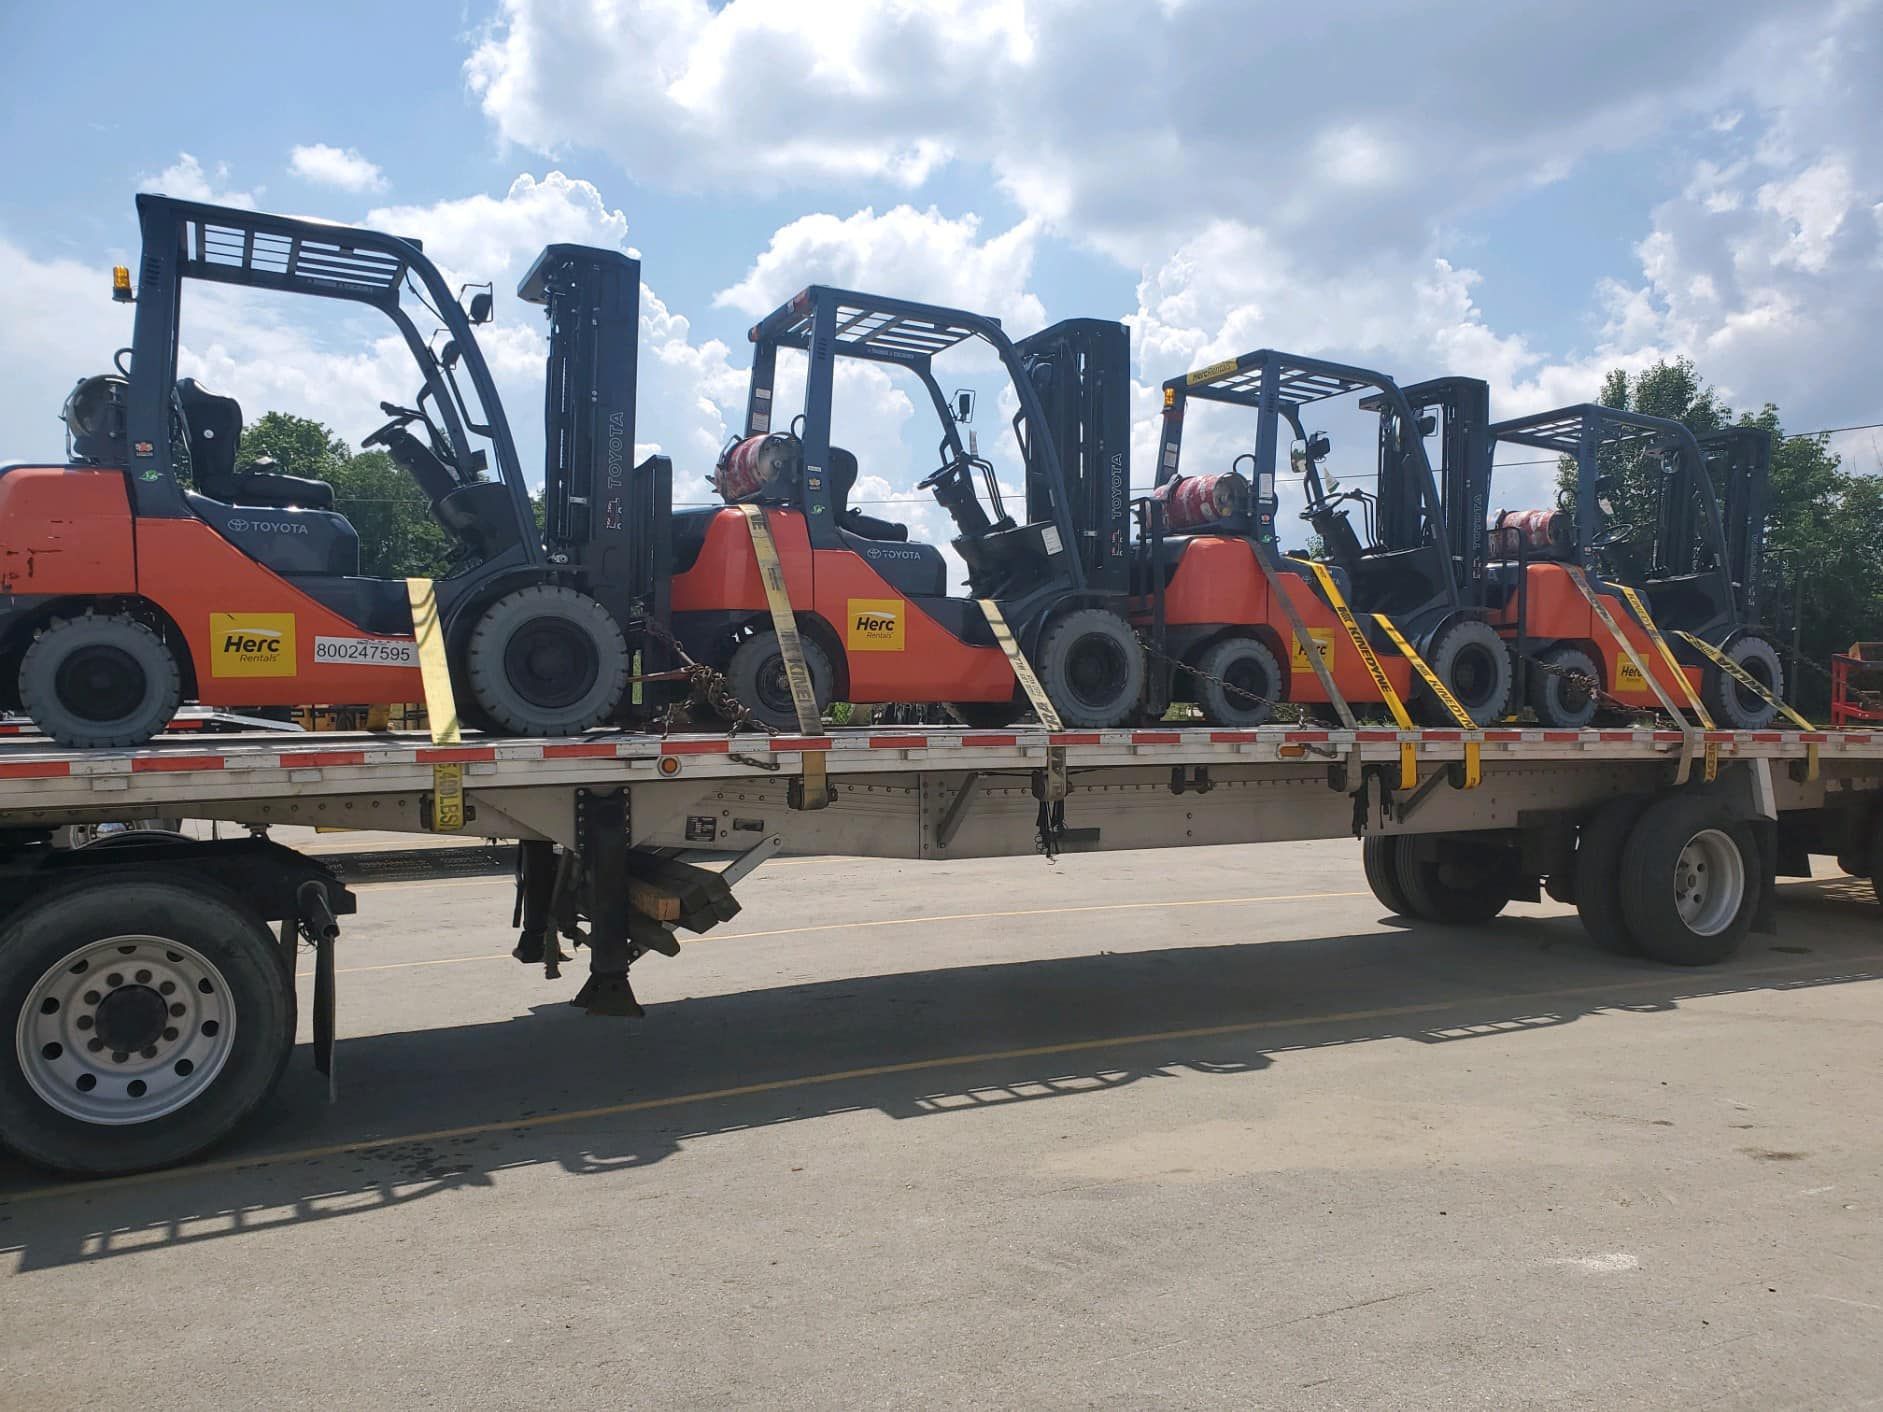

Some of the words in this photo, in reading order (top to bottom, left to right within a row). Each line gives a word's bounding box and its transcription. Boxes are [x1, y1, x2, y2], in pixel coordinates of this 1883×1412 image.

[608, 411, 625, 488] TOYOTA
[1111, 453, 1123, 519] TOYOTA
[251, 521, 309, 536] TOYOTA
[882, 549, 921, 561] TOYOTA
[856, 617, 896, 632] Herc
[866, 631, 893, 640] Rentals
[224, 635, 281, 654] Herc
[316, 643, 410, 662] 800247595
[239, 654, 278, 664] Rentals
[1348, 626, 1393, 694] KINEDYNE
